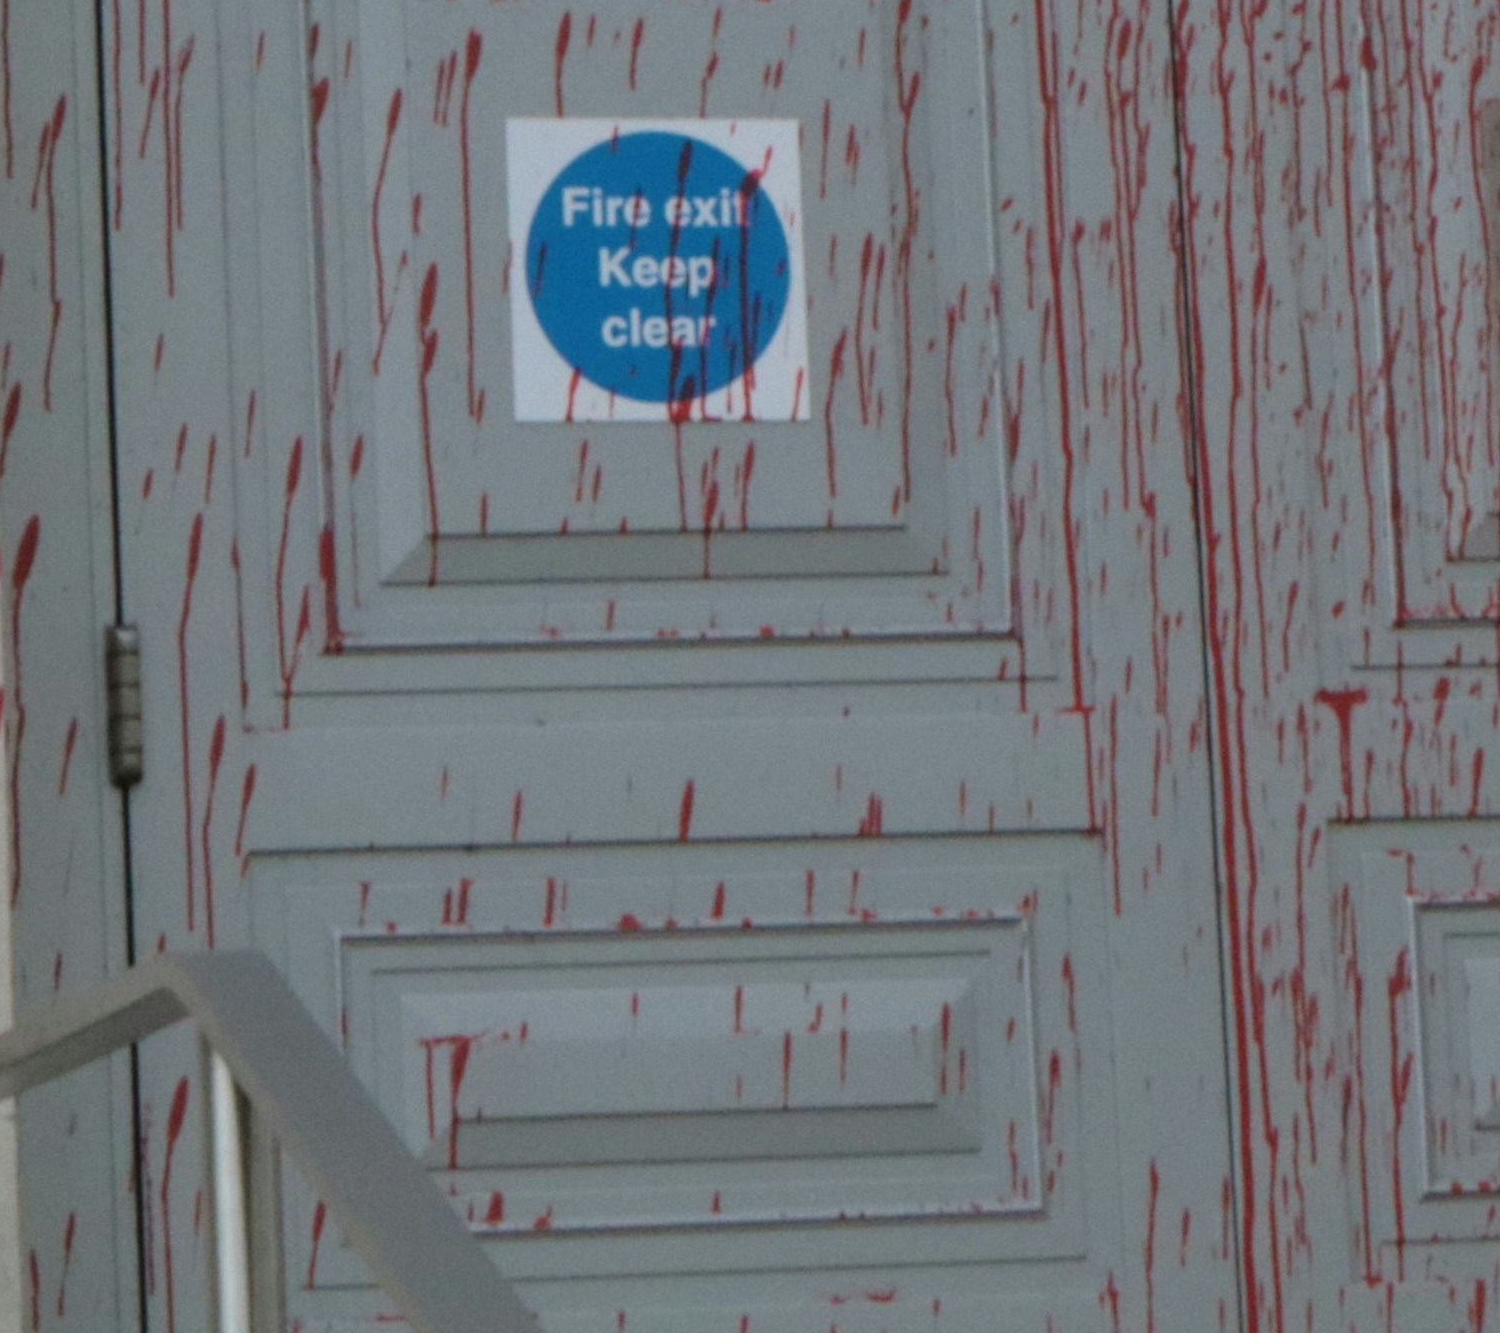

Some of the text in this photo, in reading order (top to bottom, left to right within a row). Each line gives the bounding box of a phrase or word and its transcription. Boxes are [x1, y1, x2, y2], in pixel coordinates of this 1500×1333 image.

[562, 186, 749, 226] Fire exit
[599, 246, 717, 296] Keep
[602, 307, 716, 347] clear
